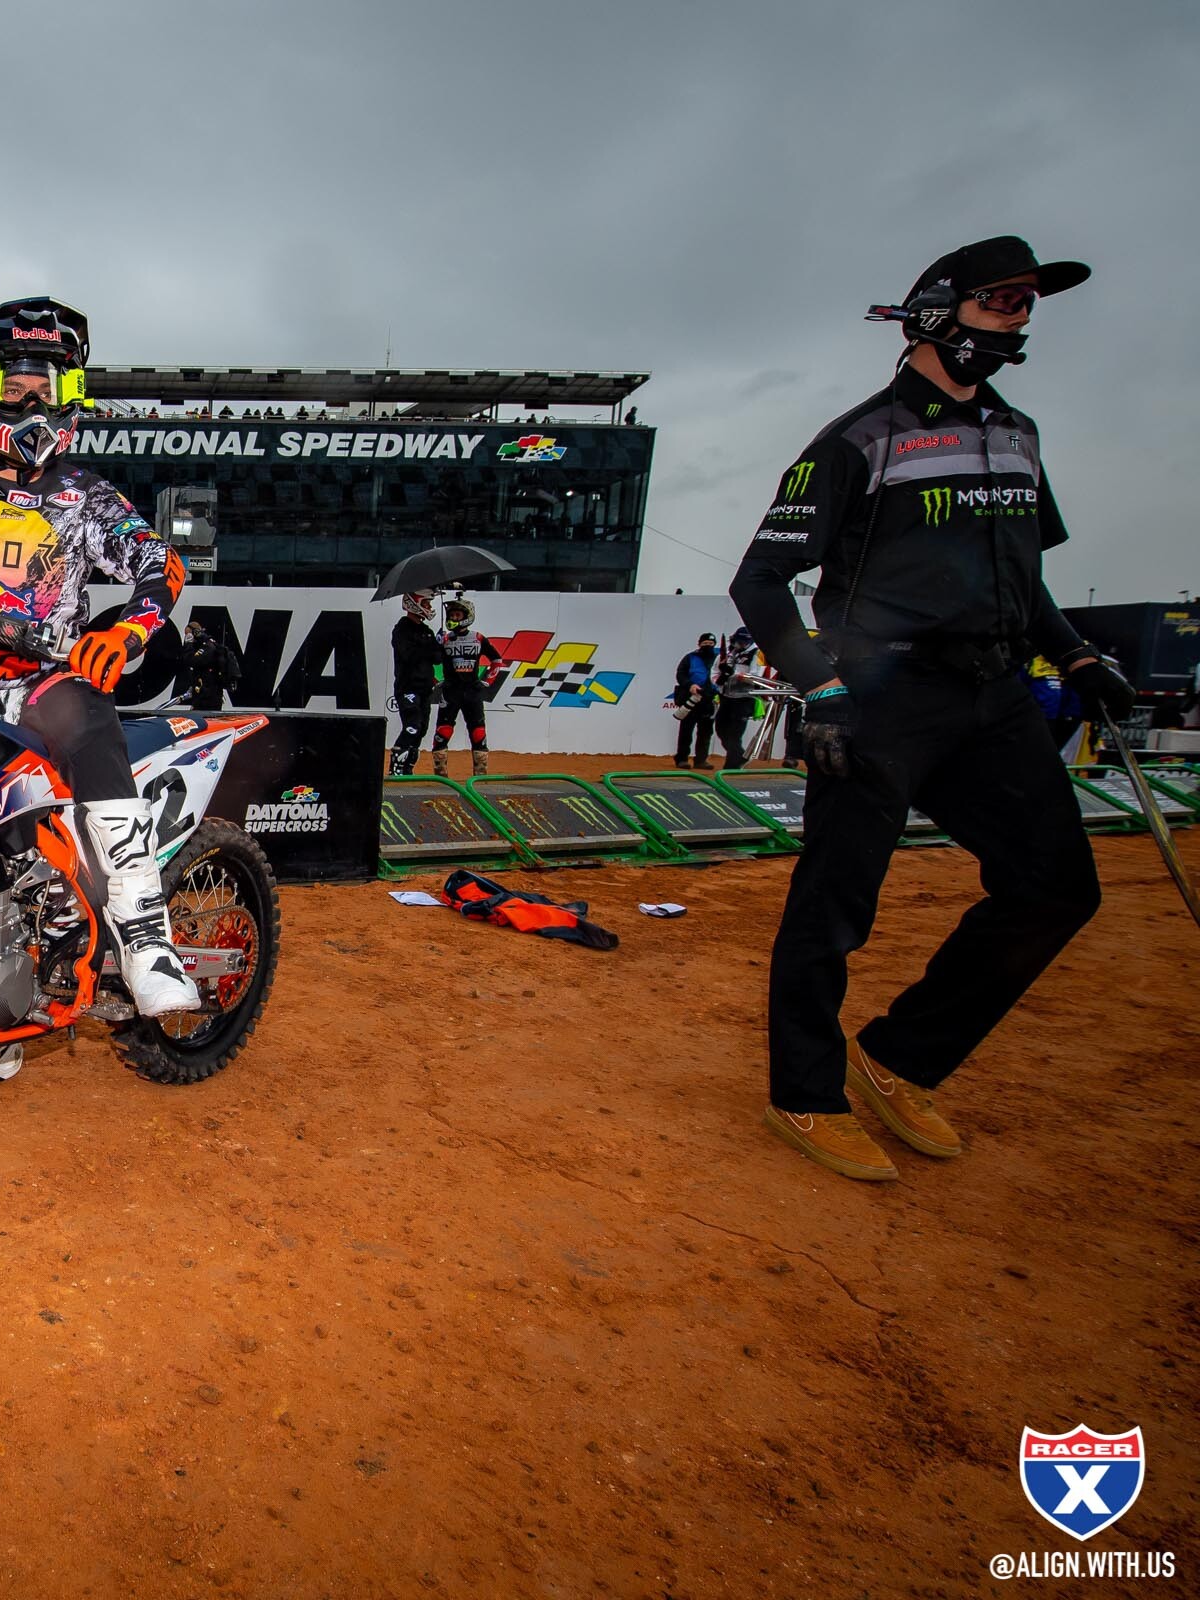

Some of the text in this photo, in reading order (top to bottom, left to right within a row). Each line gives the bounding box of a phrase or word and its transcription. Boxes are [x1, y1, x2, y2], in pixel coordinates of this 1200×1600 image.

[277, 431, 485, 459] SPEEDWAY
[896, 435, 960, 454] LUCAS OIL
[12, 494, 38, 506] 100%
[957, 487, 1037, 507] MONSTE
[975, 508, 1037, 516] ENRGY
[142, 767, 196, 851] 2
[245, 803, 328, 820] DAYTONA
[244, 820, 328, 833] SUPERCROSS
